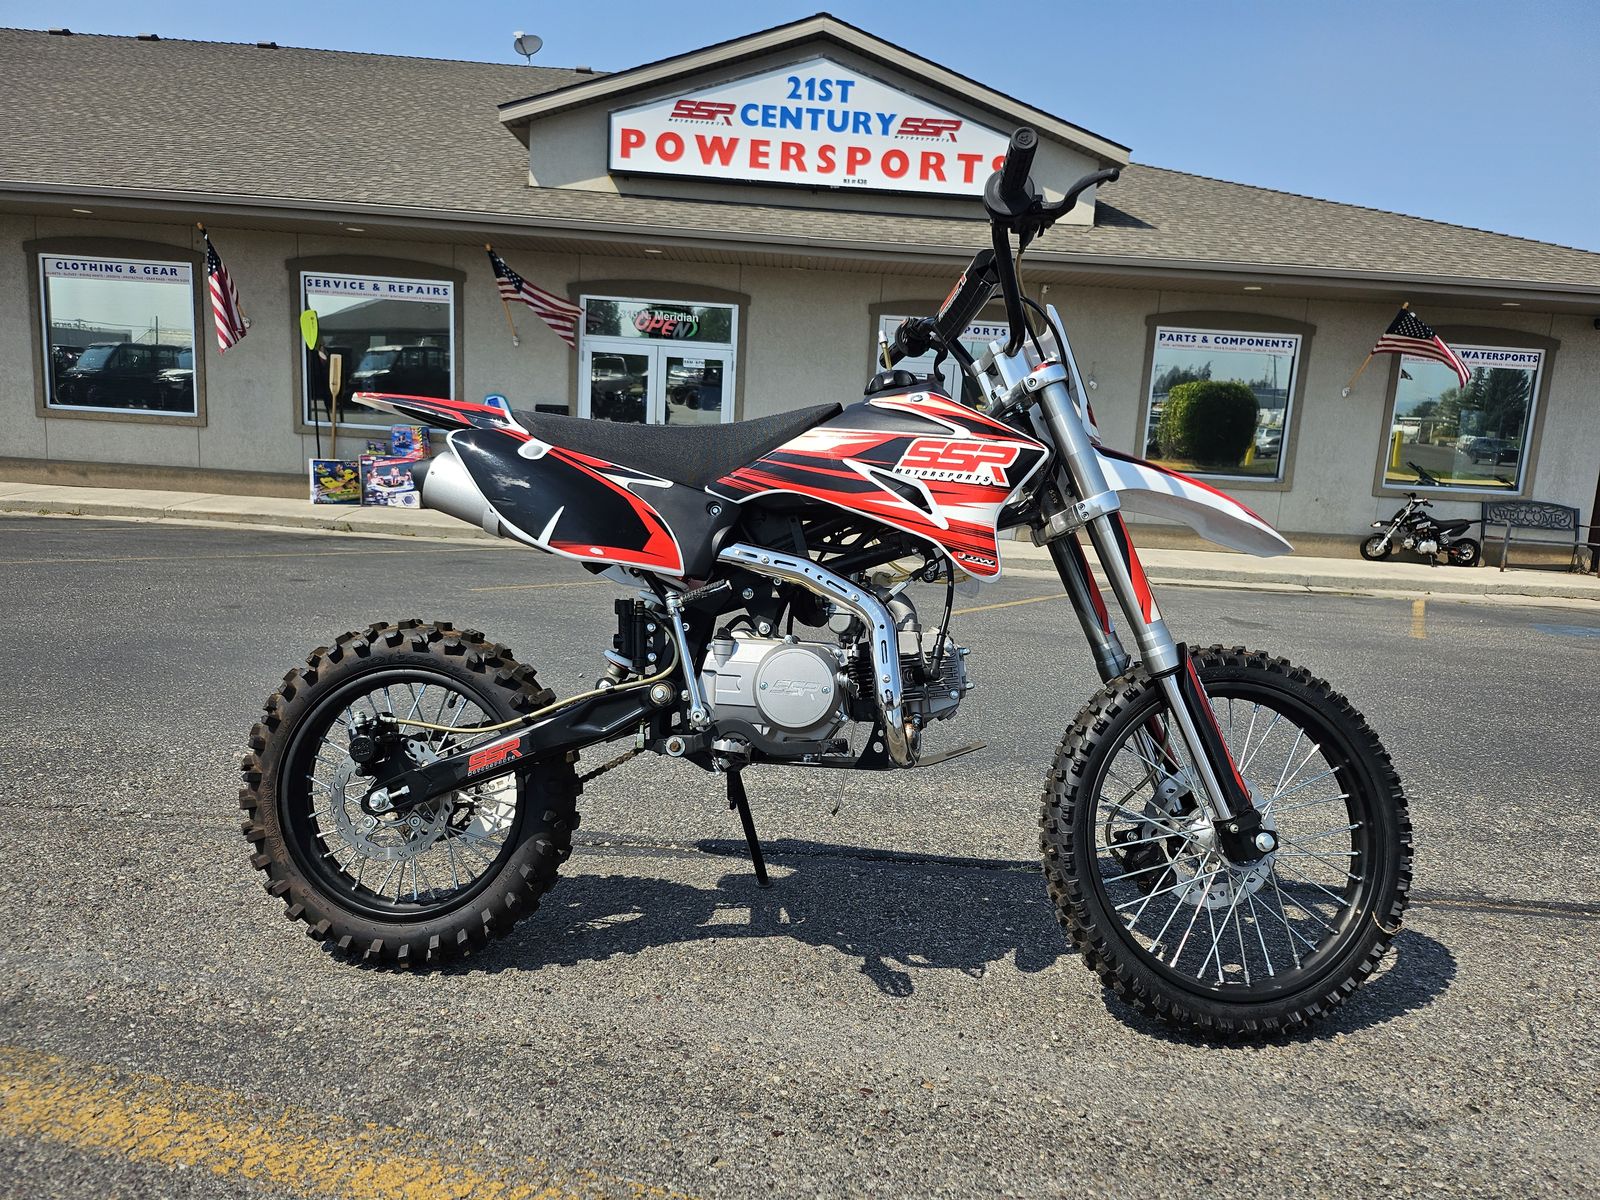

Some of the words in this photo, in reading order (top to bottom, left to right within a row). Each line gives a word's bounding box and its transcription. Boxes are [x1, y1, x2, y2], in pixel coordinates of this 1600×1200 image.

[786, 75, 856, 104] 21ST
[671, 99, 737, 127] SSR
[740, 103, 898, 137] CENTURY
[896, 117, 964, 144] SSR
[55, 261, 123, 274] CLOTHING
[128, 265, 137, 274] &
[143, 266, 178, 277] GEAR
[306, 278, 366, 291] SERVICE
[372, 283, 381, 292] &
[388, 284, 449, 296] REPAIRS
[634, 315, 692, 338] OPEN
[655, 311, 699, 322] Meridian
[1159, 333, 1197, 343] PARTS
[1201, 335, 1209, 344] &
[1214, 336, 1294, 349] COMPONENTS
[1460, 350, 1539, 363] WATERSPORTS
[899, 441, 1018, 483] SSR
[894, 467, 991, 483] MOTORSPORTS
[1499, 509, 1562, 525] WELCOME
[769, 680, 821, 701] SSR
[468, 737, 523, 771] SSR
